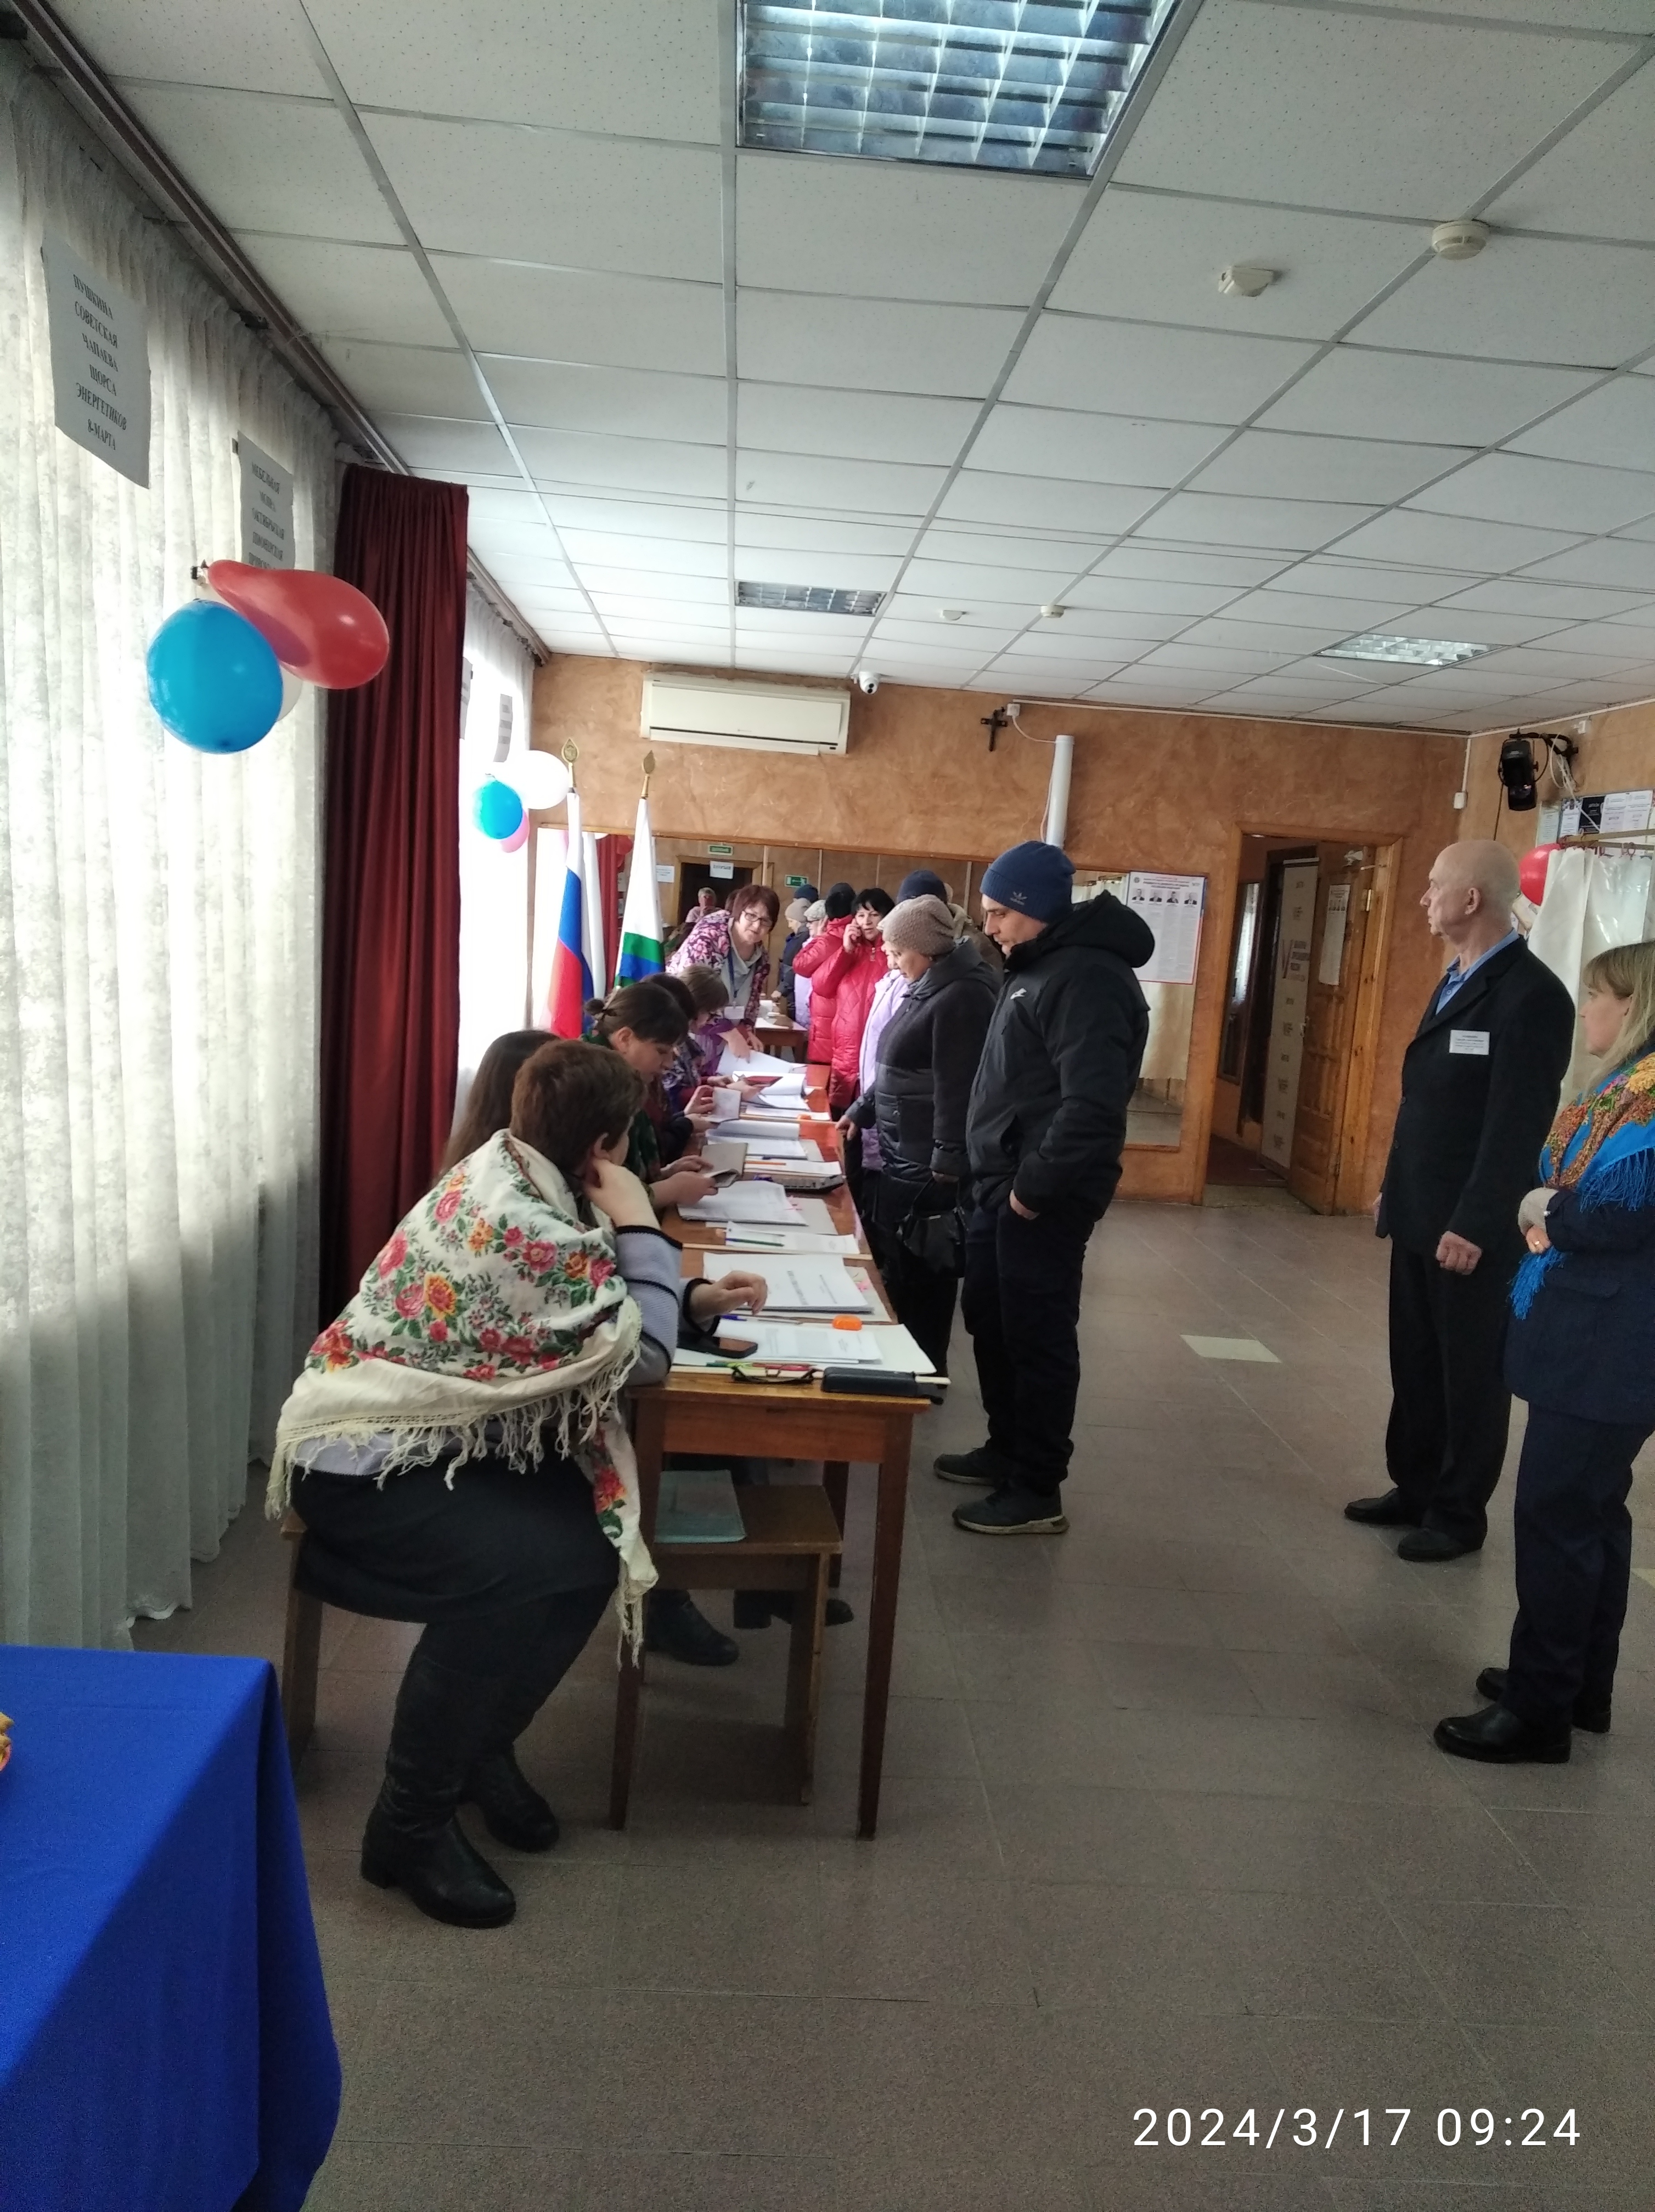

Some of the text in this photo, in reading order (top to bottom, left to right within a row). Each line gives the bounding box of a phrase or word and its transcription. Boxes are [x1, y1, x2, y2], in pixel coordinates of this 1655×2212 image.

[73, 274, 114, 320] ПУШКИНА
[75, 301, 118, 349] СОВЕТСКАЯ
[82, 332, 119, 372] ЧАПАЕВА
[89, 364, 117, 396] ЩОРСА
[76, 382, 127, 430] ЭНЕРГЕТИКОВ
[88, 419, 116, 450] 8-МАРТА
